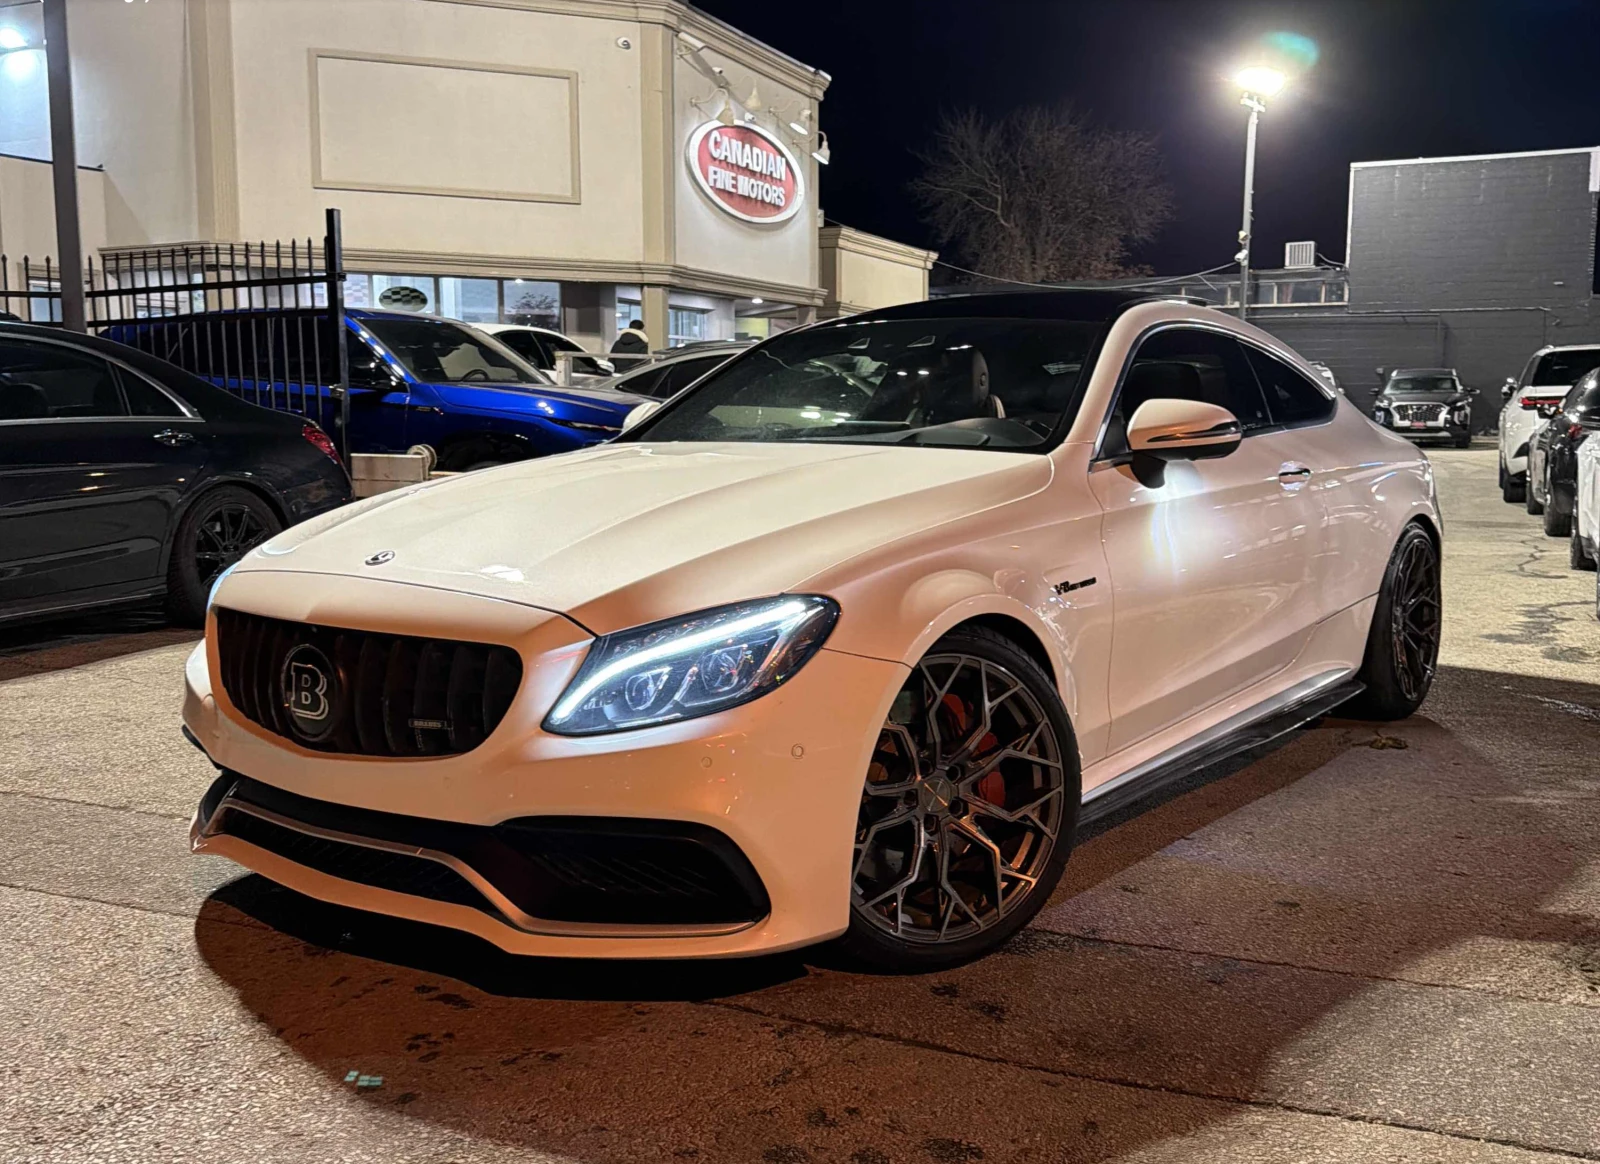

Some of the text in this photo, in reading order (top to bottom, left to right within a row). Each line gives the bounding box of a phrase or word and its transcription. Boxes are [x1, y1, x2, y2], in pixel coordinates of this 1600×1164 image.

[708, 130, 786, 181] CANADIAN
[707, 165, 785, 207] FINE MOTORS
[291, 662, 328, 720] B
